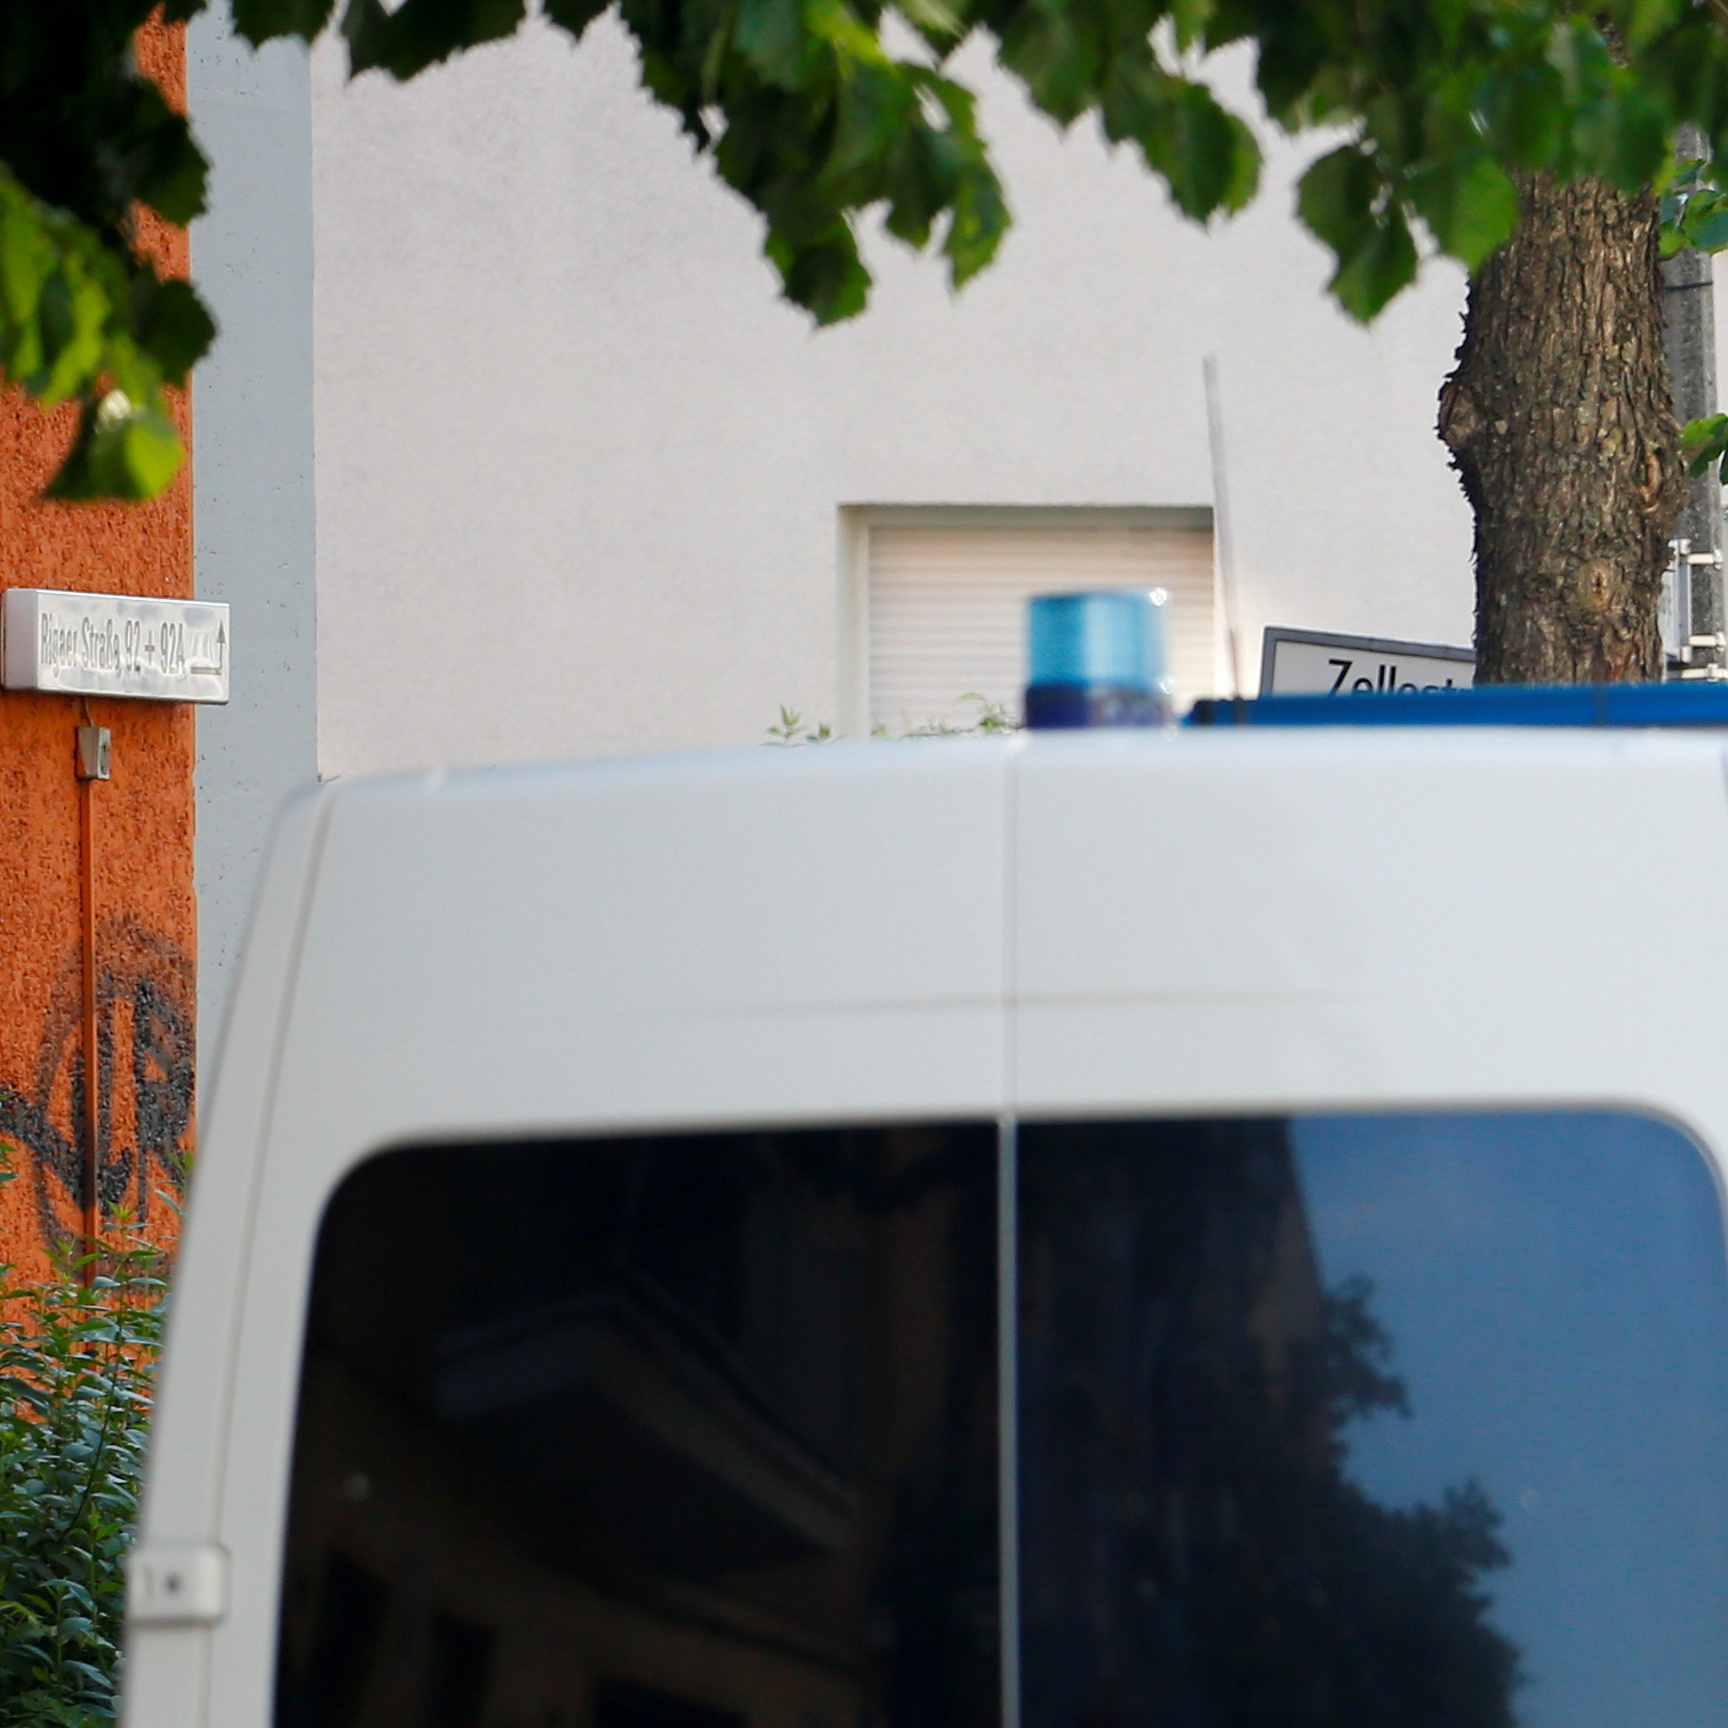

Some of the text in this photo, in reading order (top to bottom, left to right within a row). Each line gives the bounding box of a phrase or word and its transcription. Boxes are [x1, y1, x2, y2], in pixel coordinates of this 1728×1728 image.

[40, 612, 78, 678] Rigaer
[82, 616, 121, 671] Straße
[125, 619, 141, 672] 92
[160, 621, 187, 674] 92A
